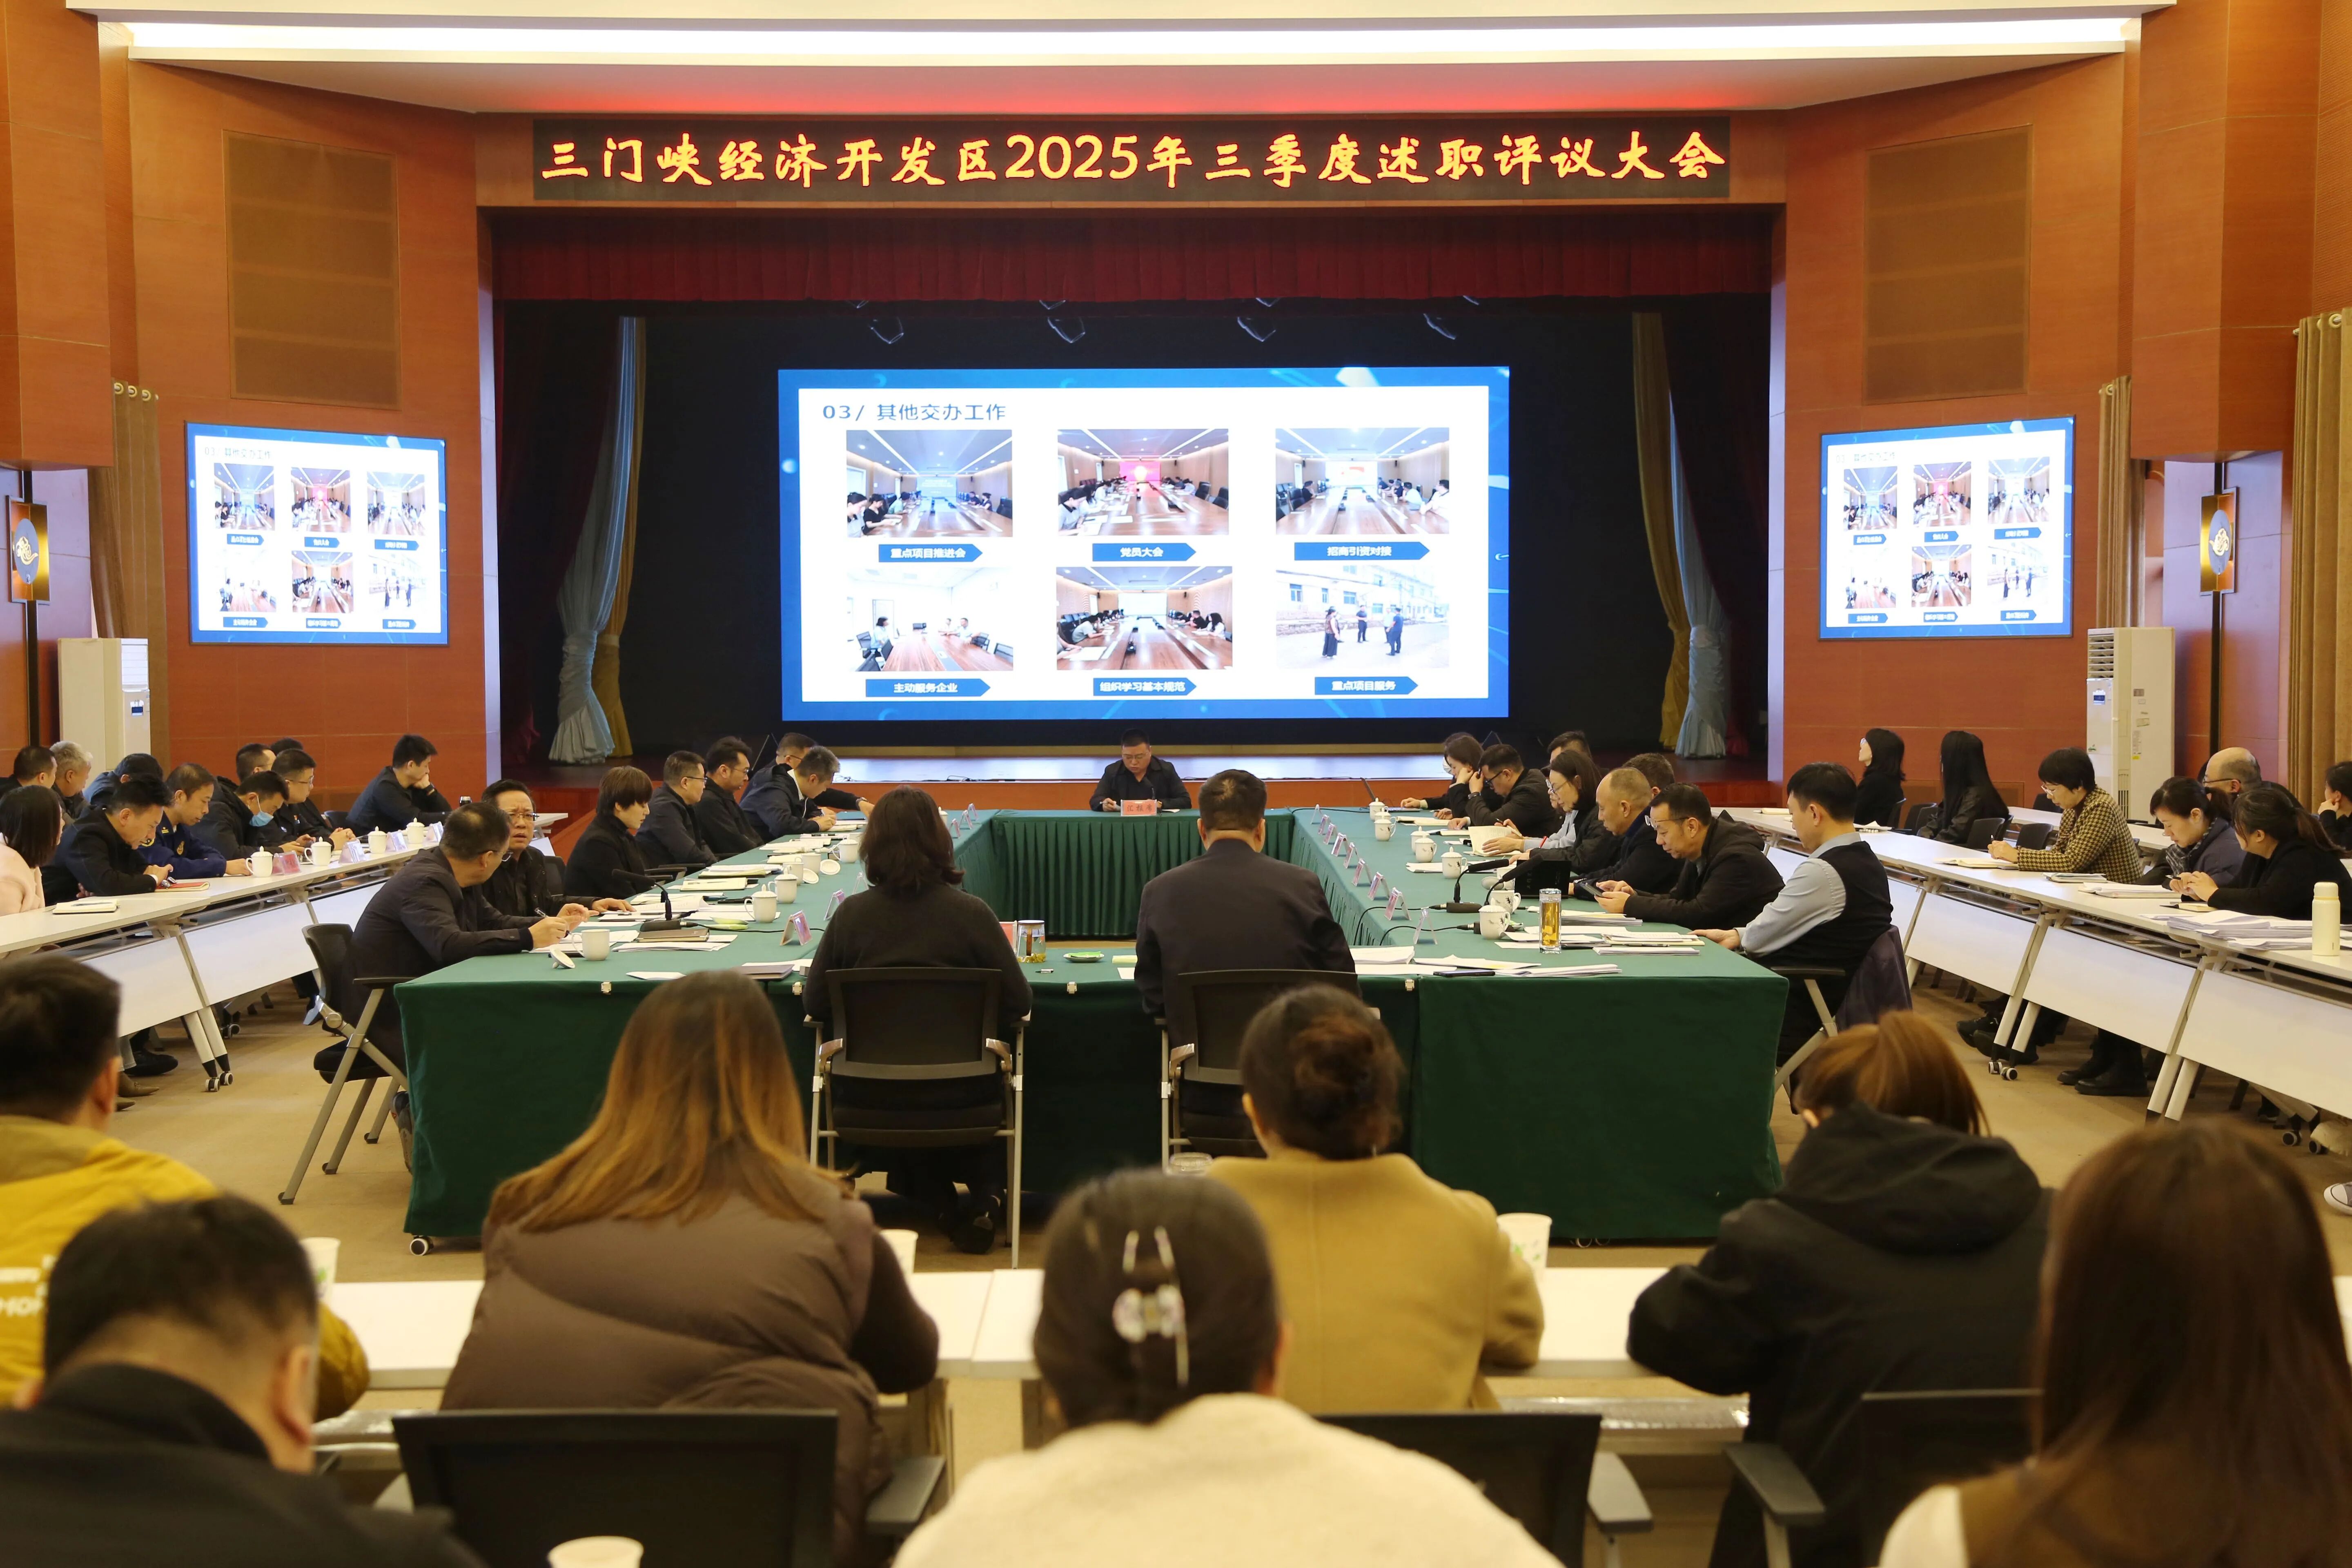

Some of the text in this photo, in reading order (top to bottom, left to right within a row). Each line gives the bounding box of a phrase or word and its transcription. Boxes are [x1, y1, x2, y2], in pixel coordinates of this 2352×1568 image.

[541, 131, 1726, 188] 三门峡经济开发区2025年三季度述职评议大会
[823, 404, 1006, 421] 03/ 其他交办工作
[1120, 547, 1163, 557] 党员大会
[1327, 546, 1392, 556] 招商引资对接
[893, 682, 958, 693] 主动服务企业
[1099, 681, 1186, 692] 组织学习基本规范
